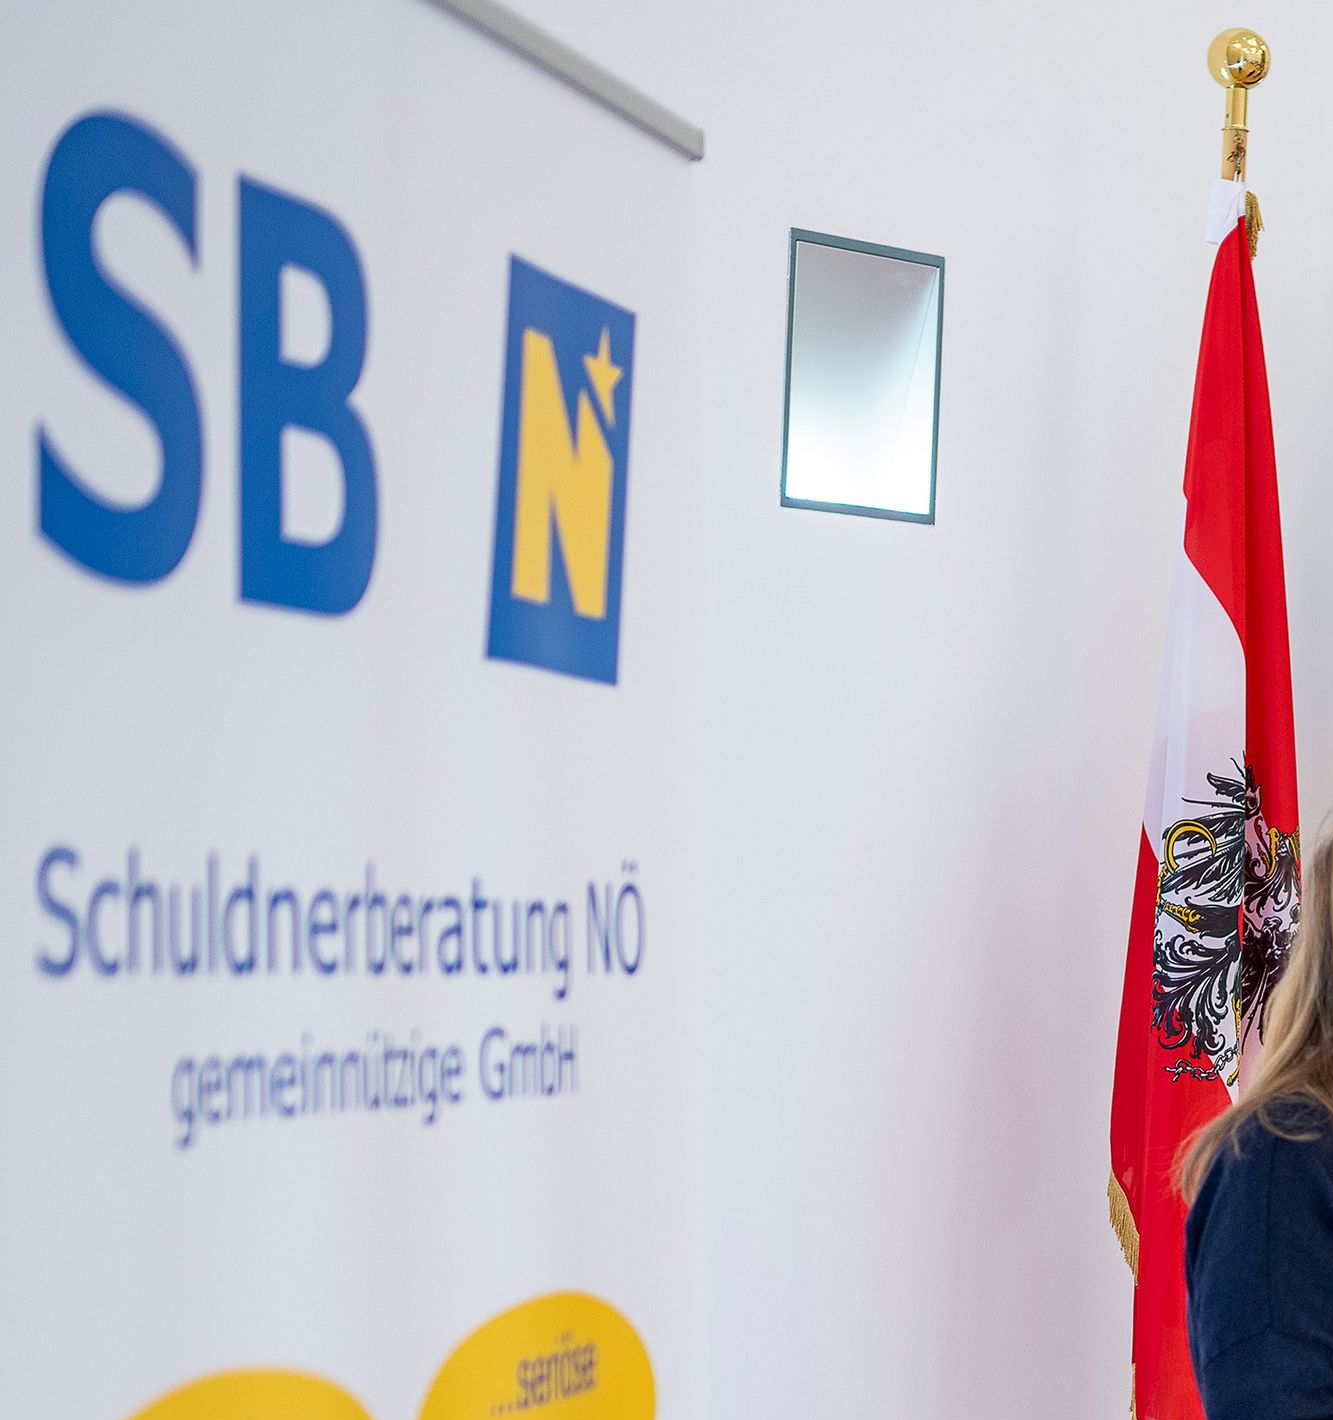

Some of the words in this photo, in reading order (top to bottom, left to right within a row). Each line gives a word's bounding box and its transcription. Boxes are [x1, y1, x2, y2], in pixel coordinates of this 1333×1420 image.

[35, 106, 380, 617] SB
[34, 843, 570, 1000] Schuldnerberatung
[586, 860, 645, 976] NÖ
[171, 1028, 465, 1150] gemeinnützige
[479, 1024, 579, 1100] GmbH
